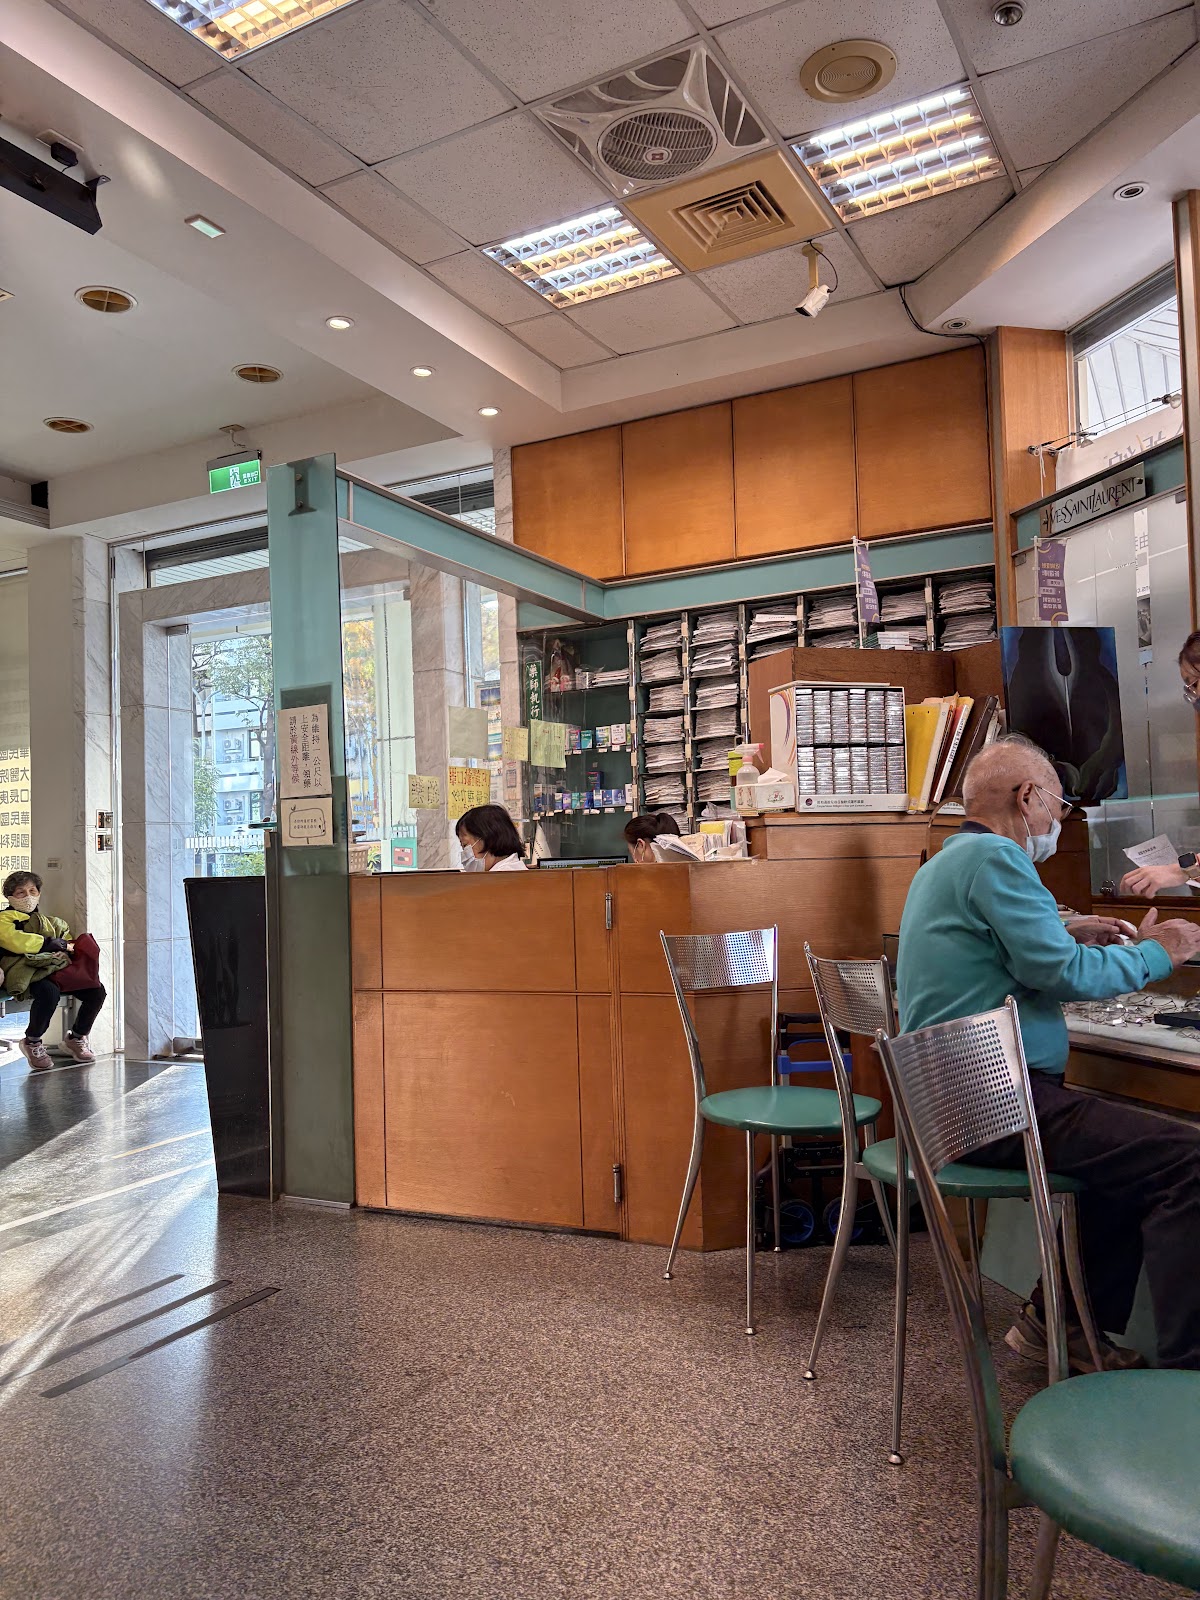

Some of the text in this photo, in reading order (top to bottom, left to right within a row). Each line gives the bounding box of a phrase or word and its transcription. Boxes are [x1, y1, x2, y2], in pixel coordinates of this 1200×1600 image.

[243, 476, 258, 484] EXIT
[529, 663, 541, 720] 藥師執行
